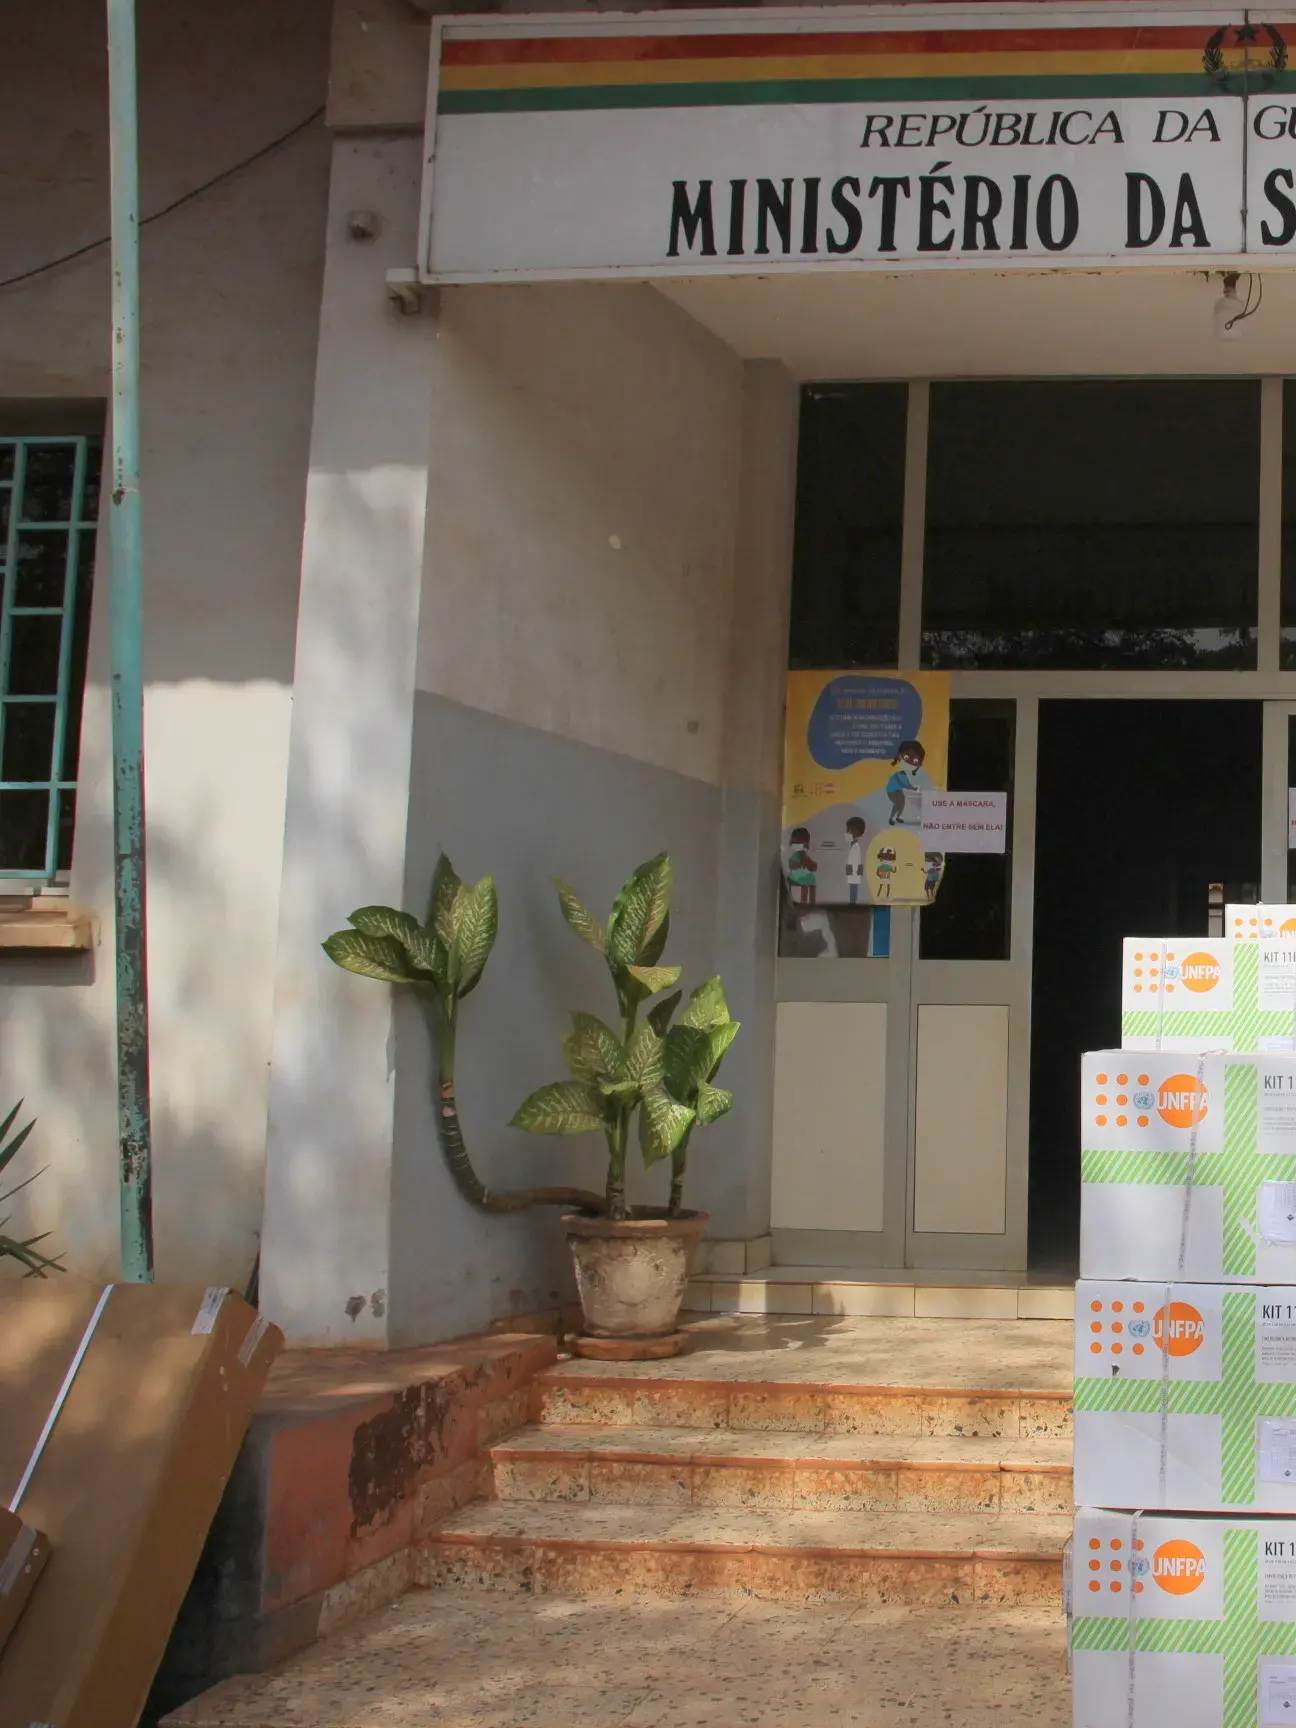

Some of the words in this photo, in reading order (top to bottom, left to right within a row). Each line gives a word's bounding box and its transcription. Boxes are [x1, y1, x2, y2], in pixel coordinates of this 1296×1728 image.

[860, 106, 1125, 148] REPÚBLICA
[1152, 109, 1222, 144] DA
[665, 161, 1080, 257] MINISTÉRIO
[1124, 172, 1211, 249] DA
[923, 822, 940, 830] NÃO
[1263, 951, 1279, 963] KIT
[1180, 965, 1221, 980] UNFPA
[1264, 1075, 1284, 1090] KIT
[1262, 1304, 1283, 1320] KIT
[1152, 1318, 1205, 1339] UNFPA
[1264, 1541, 1285, 1556] KIT
[1152, 1556, 1207, 1577] UNFPA
